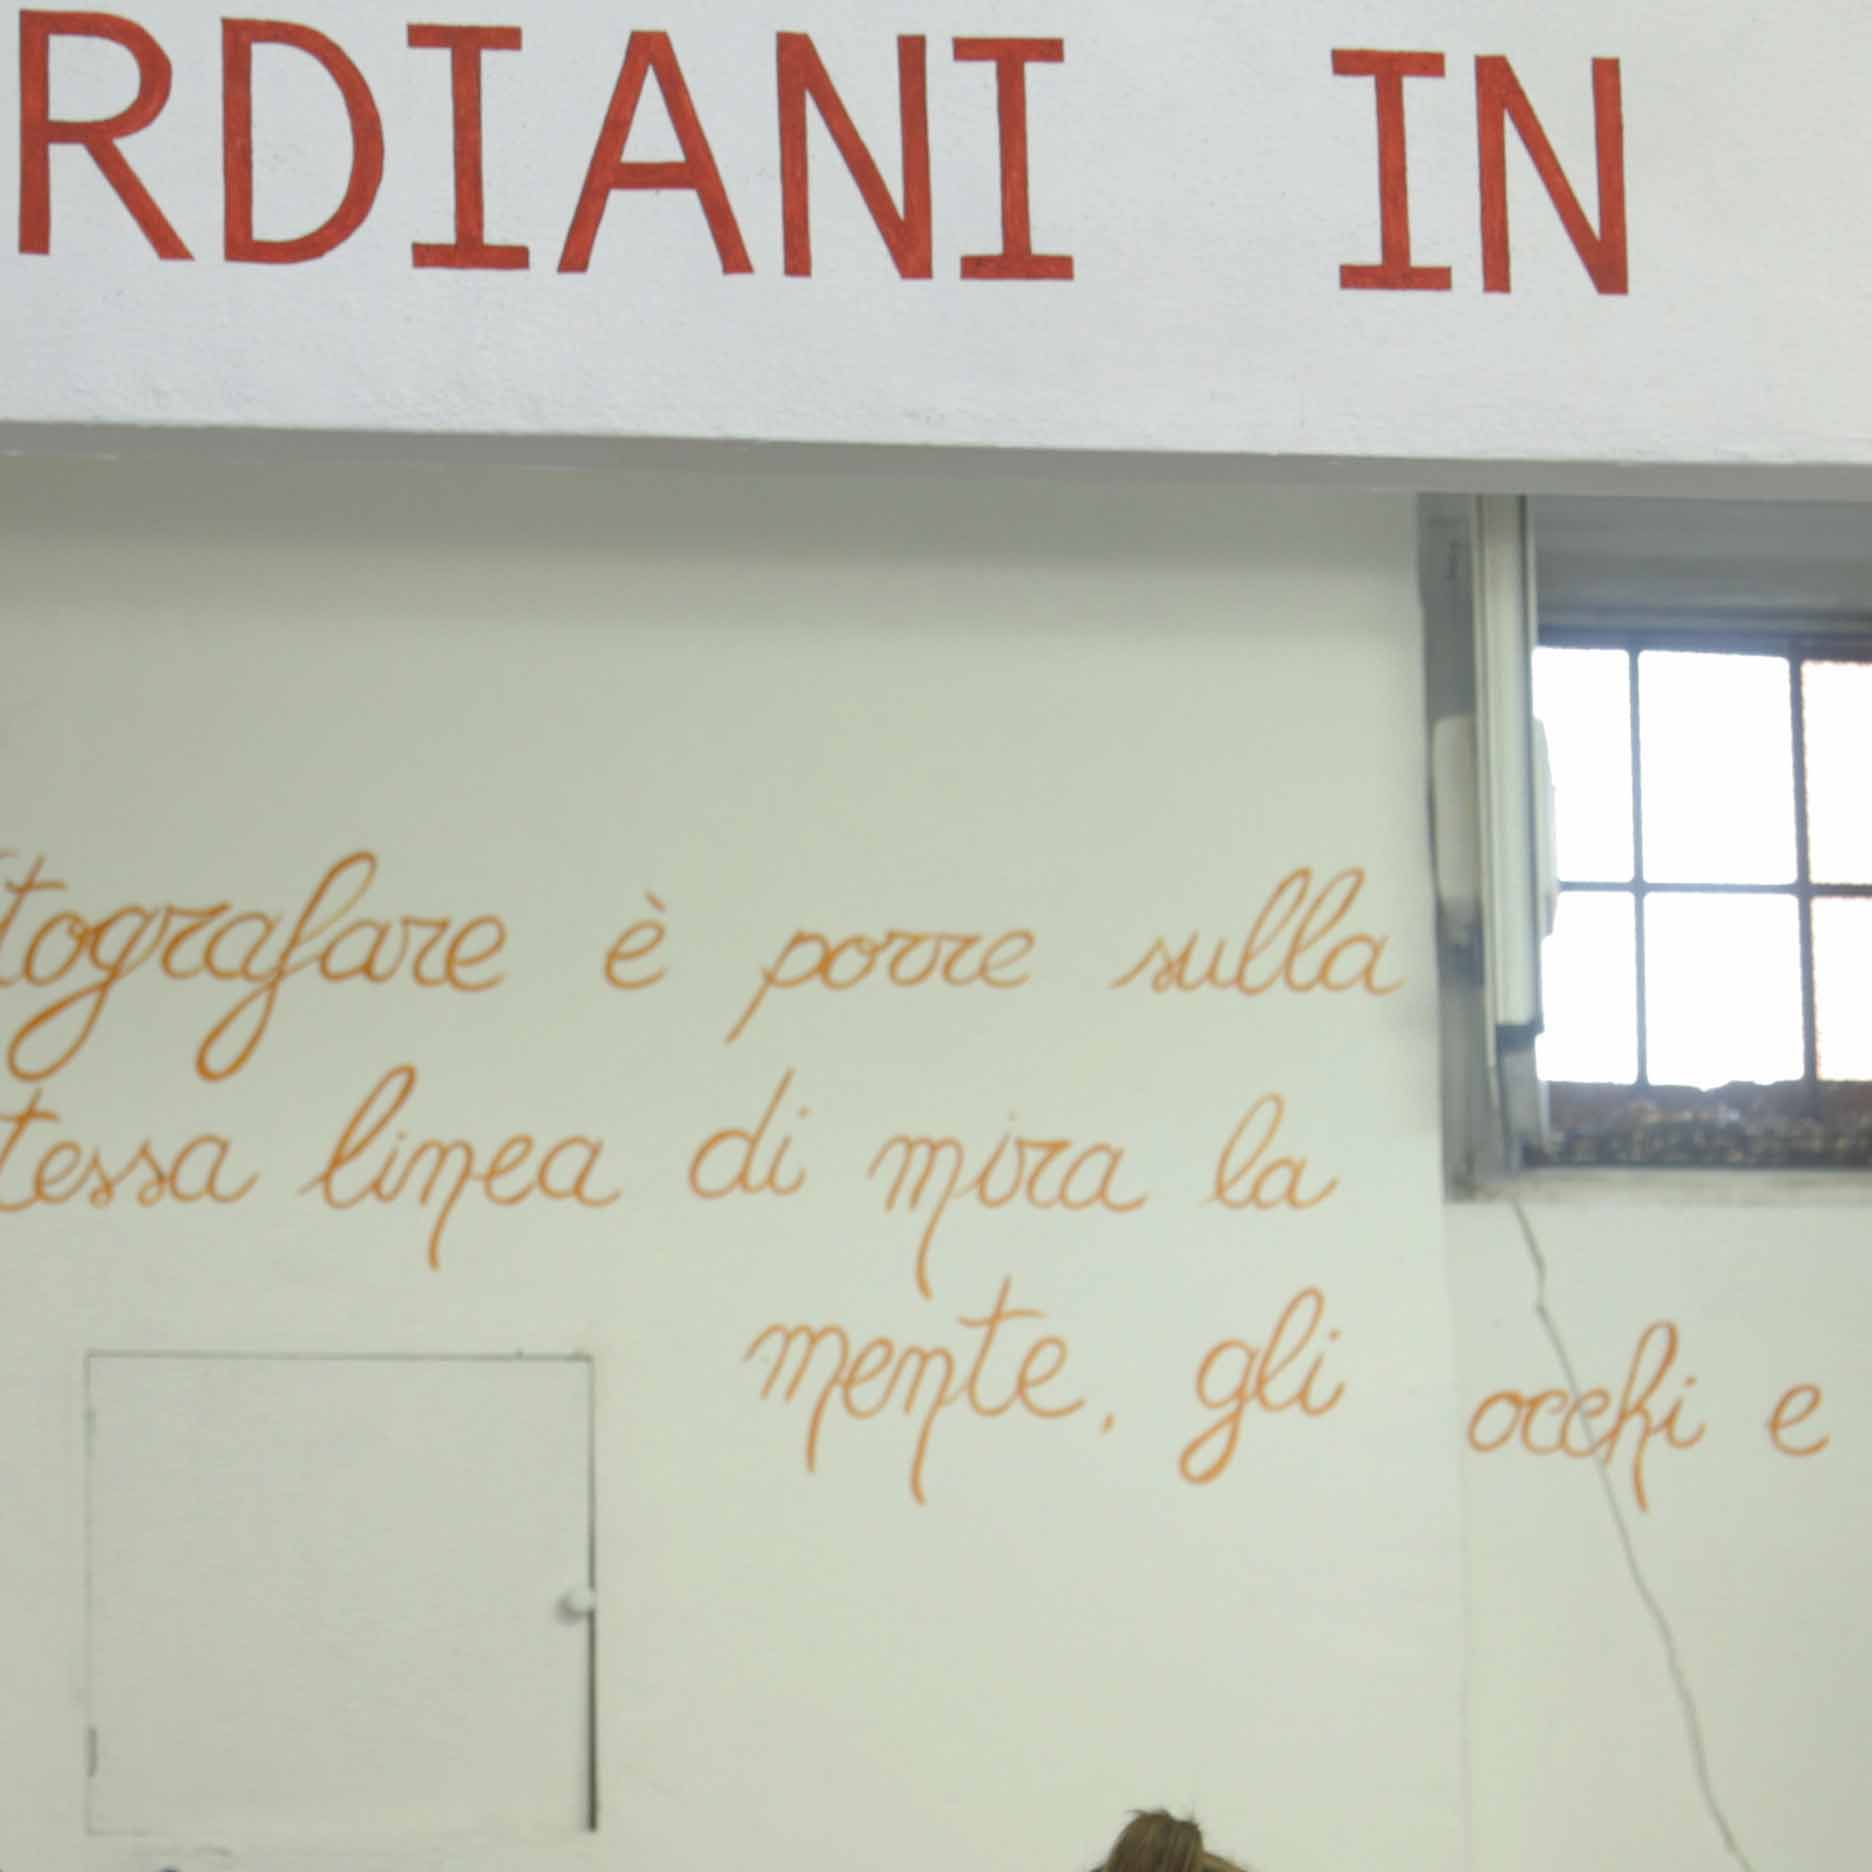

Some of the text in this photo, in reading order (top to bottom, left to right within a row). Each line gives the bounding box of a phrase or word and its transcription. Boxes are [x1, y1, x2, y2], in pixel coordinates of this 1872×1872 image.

[1331, 46, 1630, 295] IN
[603, 893, 669, 991] è
[725, 924, 1037, 1044] porre
[1111, 866, 1408, 997] sulla
[300, 1064, 620, 1272] linea
[688, 1069, 810, 1199] di
[868, 1112, 1148, 1301] mira
[1206, 1092, 1340, 1210] la
[743, 1276, 1118, 1506] mente,
[1178, 1288, 1348, 1486] gli
[1465, 1320, 1707, 1512] occhi
[1768, 1382, 1831, 1457] e
